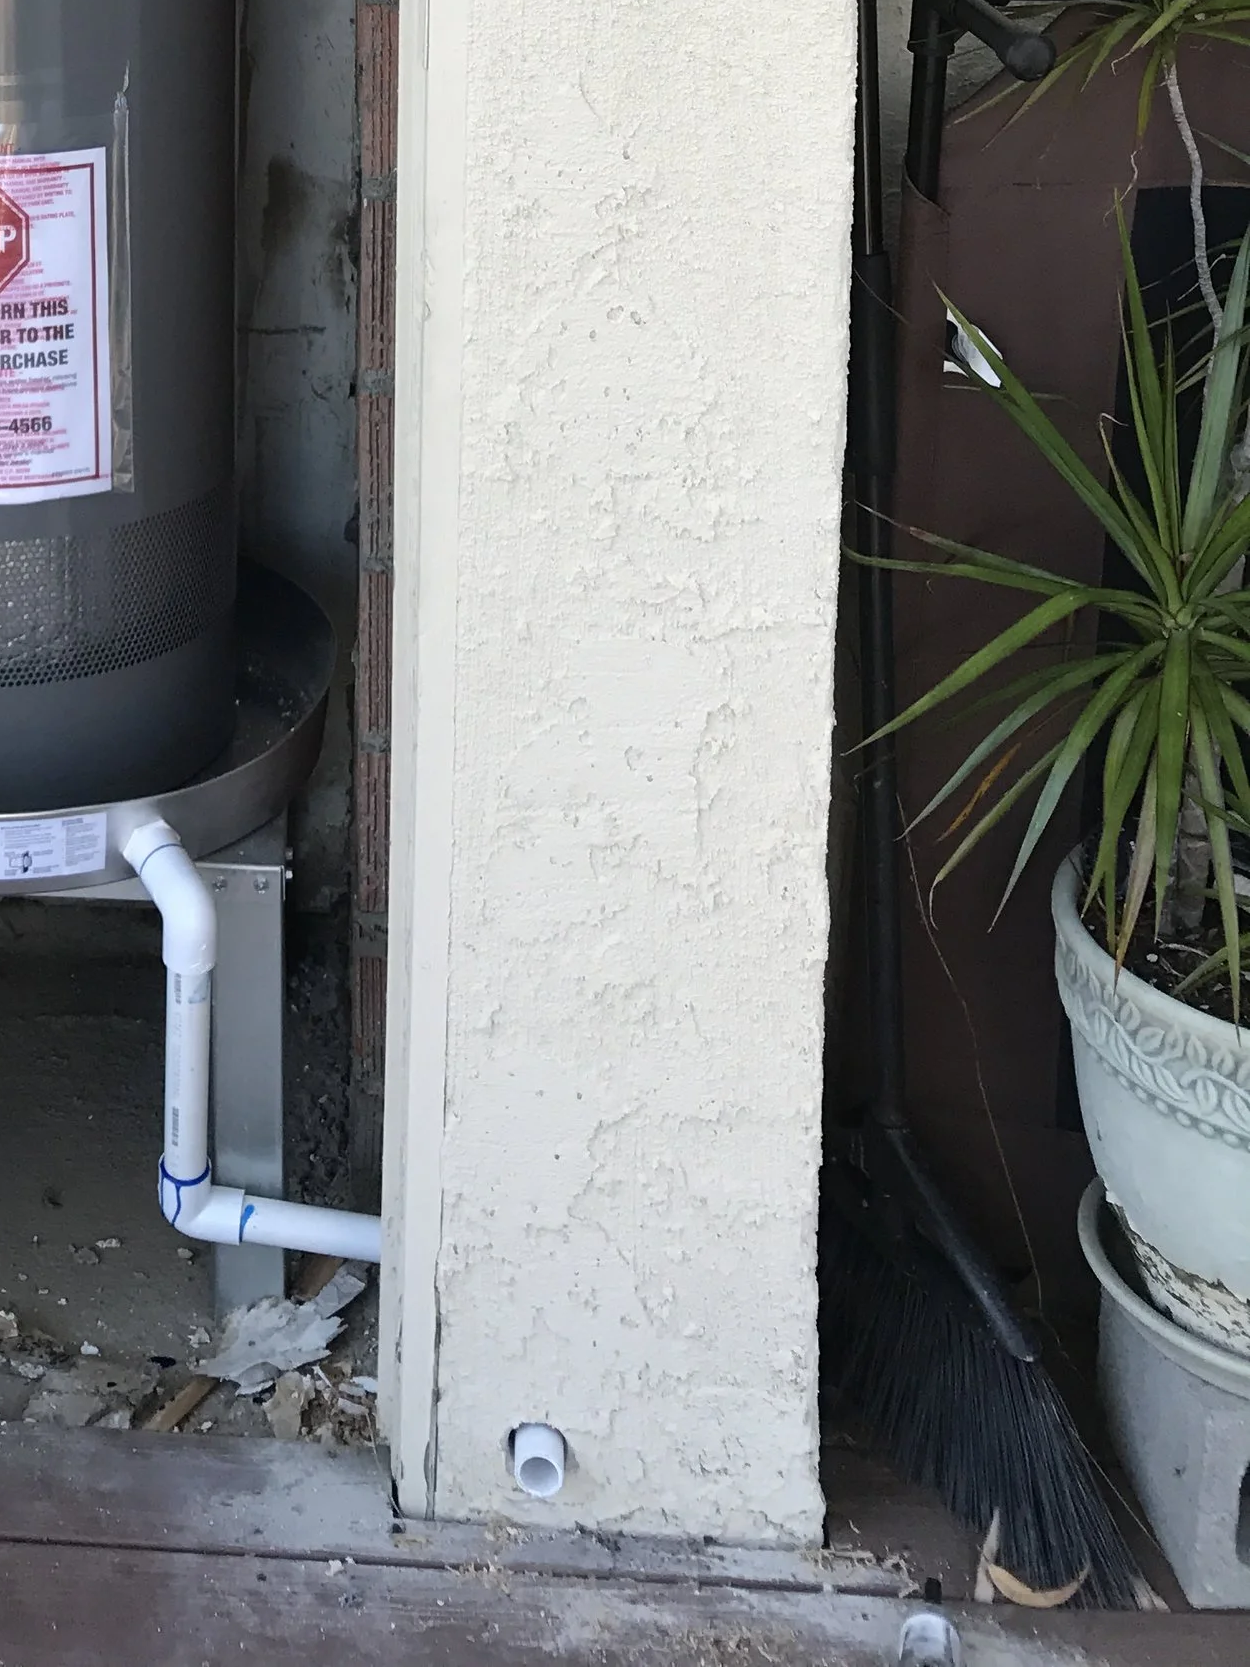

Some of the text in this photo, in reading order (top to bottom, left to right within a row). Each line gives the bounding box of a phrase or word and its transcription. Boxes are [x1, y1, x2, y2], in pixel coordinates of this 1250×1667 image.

[30, 298, 69, 319] THIS
[16, 326, 41, 345] TO
[43, 323, 75, 341] THE
